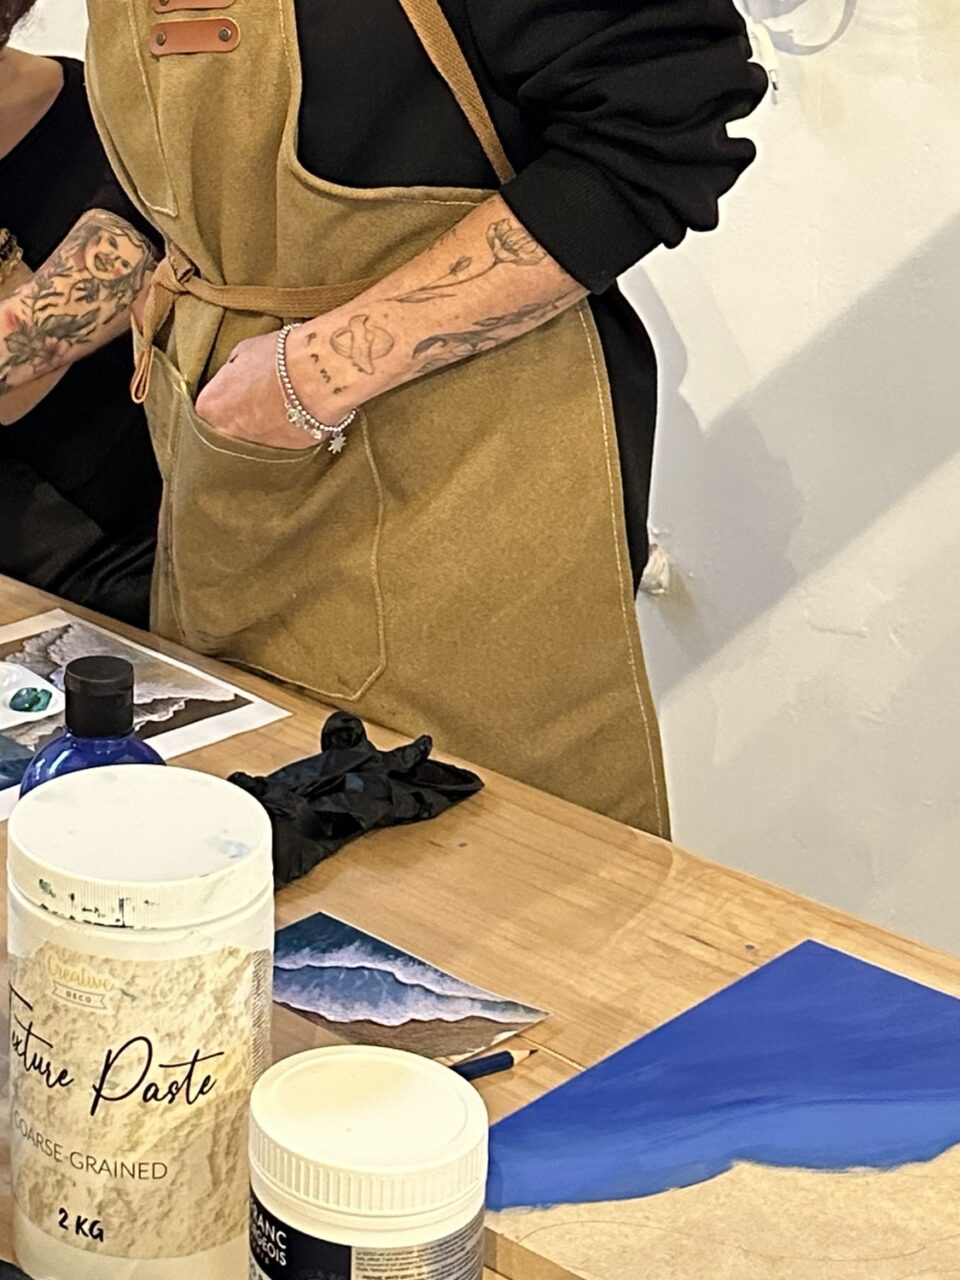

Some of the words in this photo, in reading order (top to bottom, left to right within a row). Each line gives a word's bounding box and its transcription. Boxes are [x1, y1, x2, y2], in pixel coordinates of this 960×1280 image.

[65, 990, 92, 1004] DECO
[90, 1036, 225, 1117] Paste
[13, 1109, 168, 1180] COARSE-GRAINED
[58, 1207, 69, 1230] 2
[75, 1215, 104, 1242] KG
